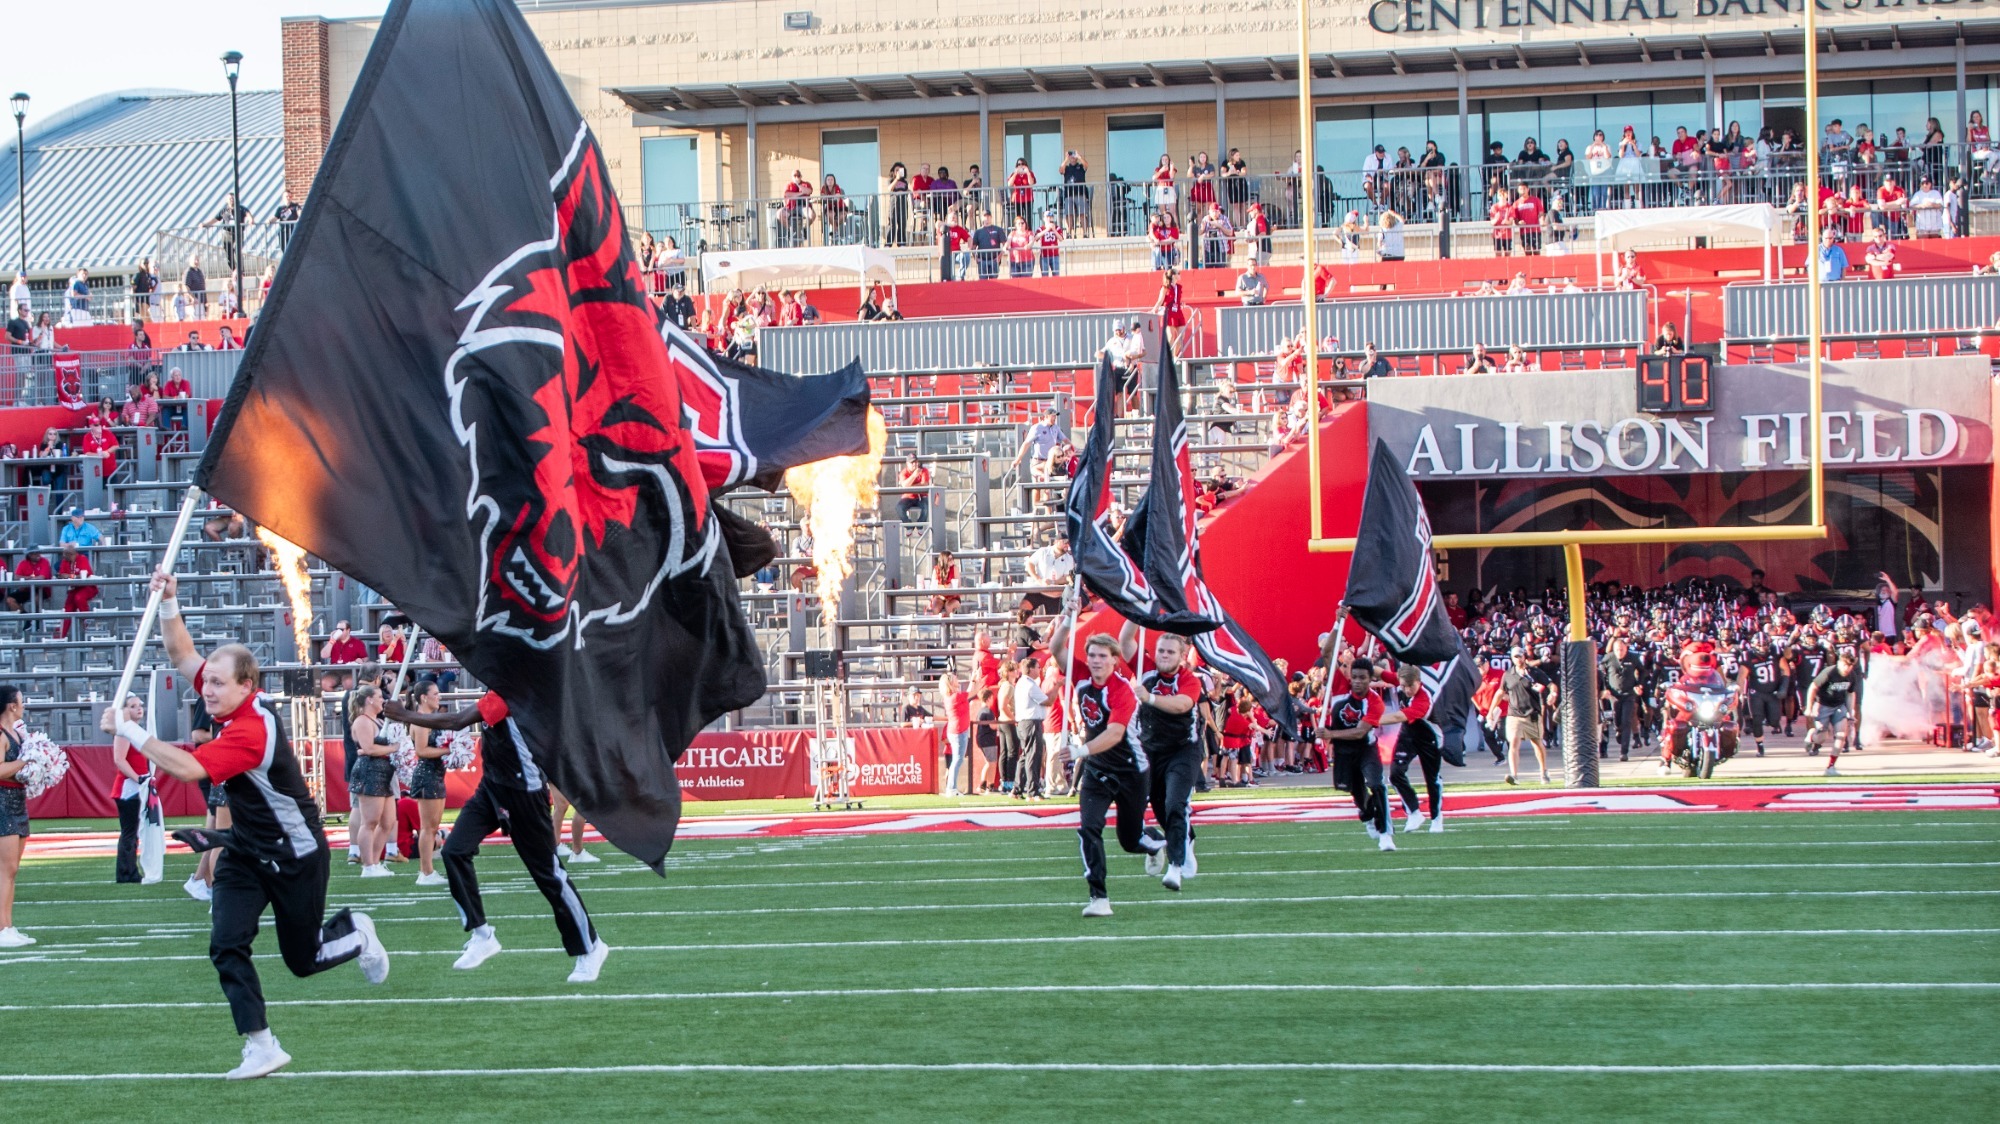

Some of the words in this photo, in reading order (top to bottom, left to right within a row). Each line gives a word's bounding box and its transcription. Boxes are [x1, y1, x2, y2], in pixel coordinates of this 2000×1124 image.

[1368, 0, 1678, 34] CENTENNIAL
[1642, 357, 1709, 406] 40
[1405, 415, 1714, 476] ALLISON
[1740, 408, 1959, 467] FIELD
[1756, 664, 1775, 684] 91
[1810, 658, 1821, 677] 7
[696, 775, 745, 788] Athletics
[861, 774, 922, 786] HEALTHCARE
